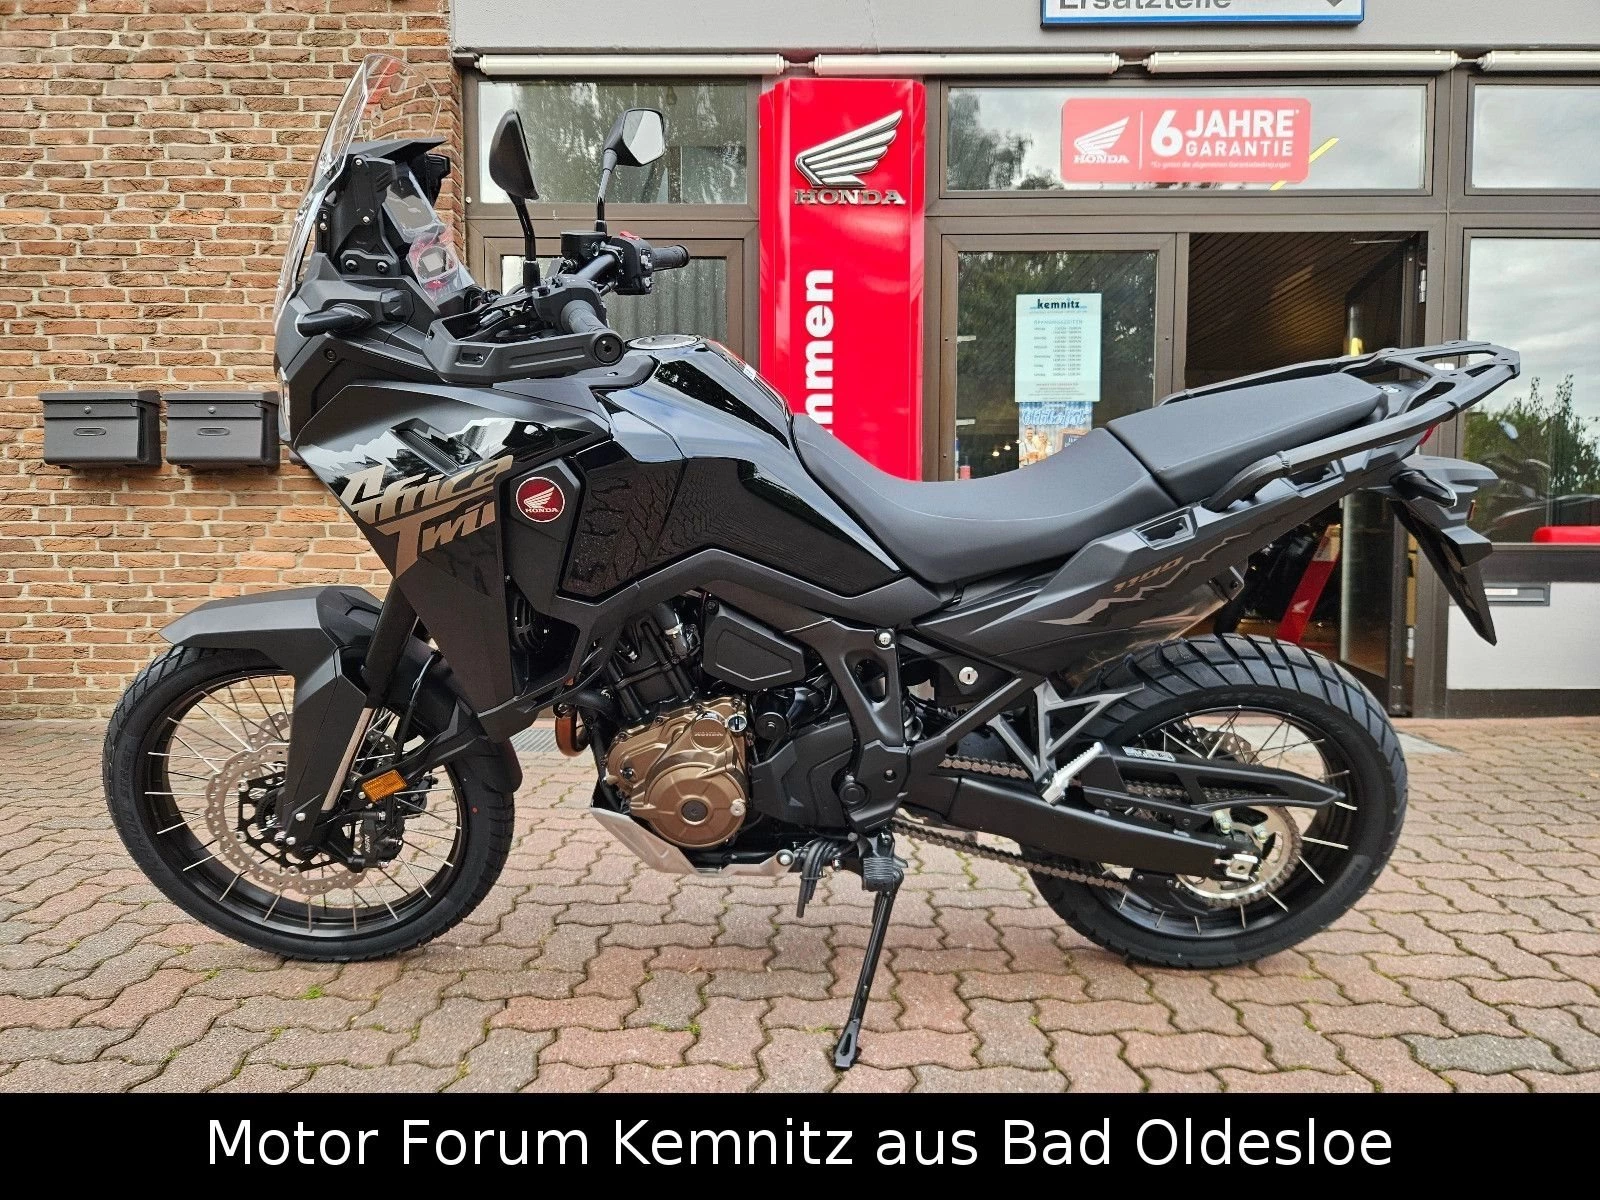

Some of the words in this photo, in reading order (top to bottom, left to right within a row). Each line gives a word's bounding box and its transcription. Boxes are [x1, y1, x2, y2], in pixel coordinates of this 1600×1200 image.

[1151, 109, 1183, 157] 6
[1186, 141, 1293, 157] GARANTIE
[1073, 153, 1130, 164] HONDA
[795, 189, 906, 205] HONDA
[1037, 298, 1080, 309] kemnitz
[341, 454, 514, 525] Africa
[1113, 556, 1184, 593] 1100
